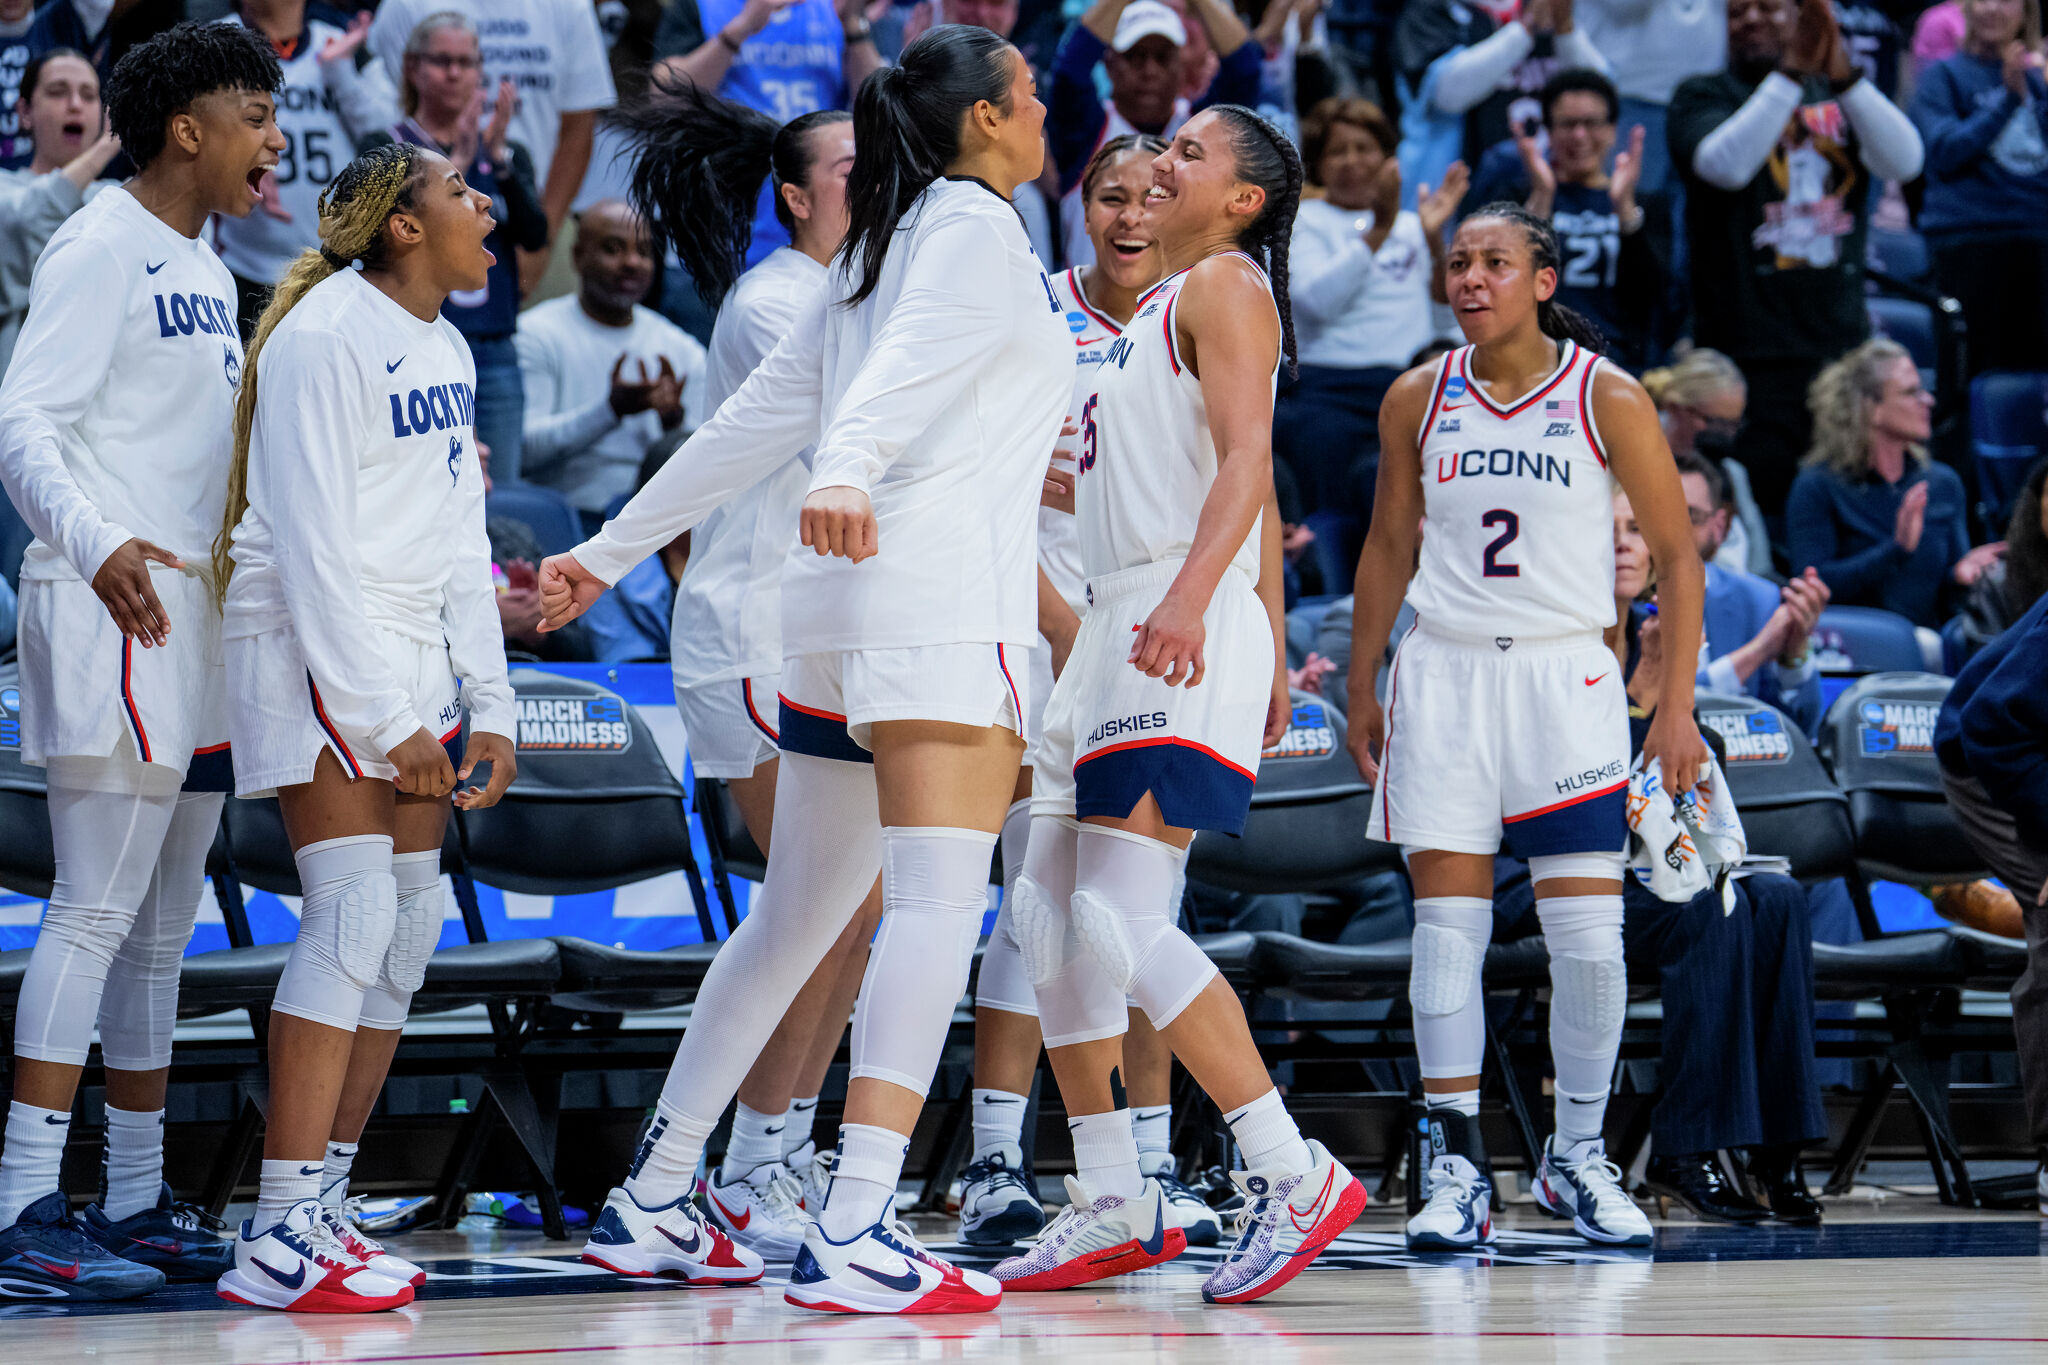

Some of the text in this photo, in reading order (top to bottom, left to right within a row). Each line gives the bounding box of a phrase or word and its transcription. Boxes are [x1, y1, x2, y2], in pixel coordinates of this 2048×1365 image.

[1565, 234, 1621, 287] 21
[154, 292, 225, 338] LOCK
[389, 385, 458, 438] LOCK
[1437, 448, 1571, 488] UCONN
[1482, 508, 1520, 577] 2
[439, 697, 461, 725] HUS
[1087, 711, 1168, 747] HUSKIES
[520, 721, 628, 744] MADNESS
[1725, 732, 1789, 756] DNESS
[1555, 759, 1625, 795] HUSKIES
